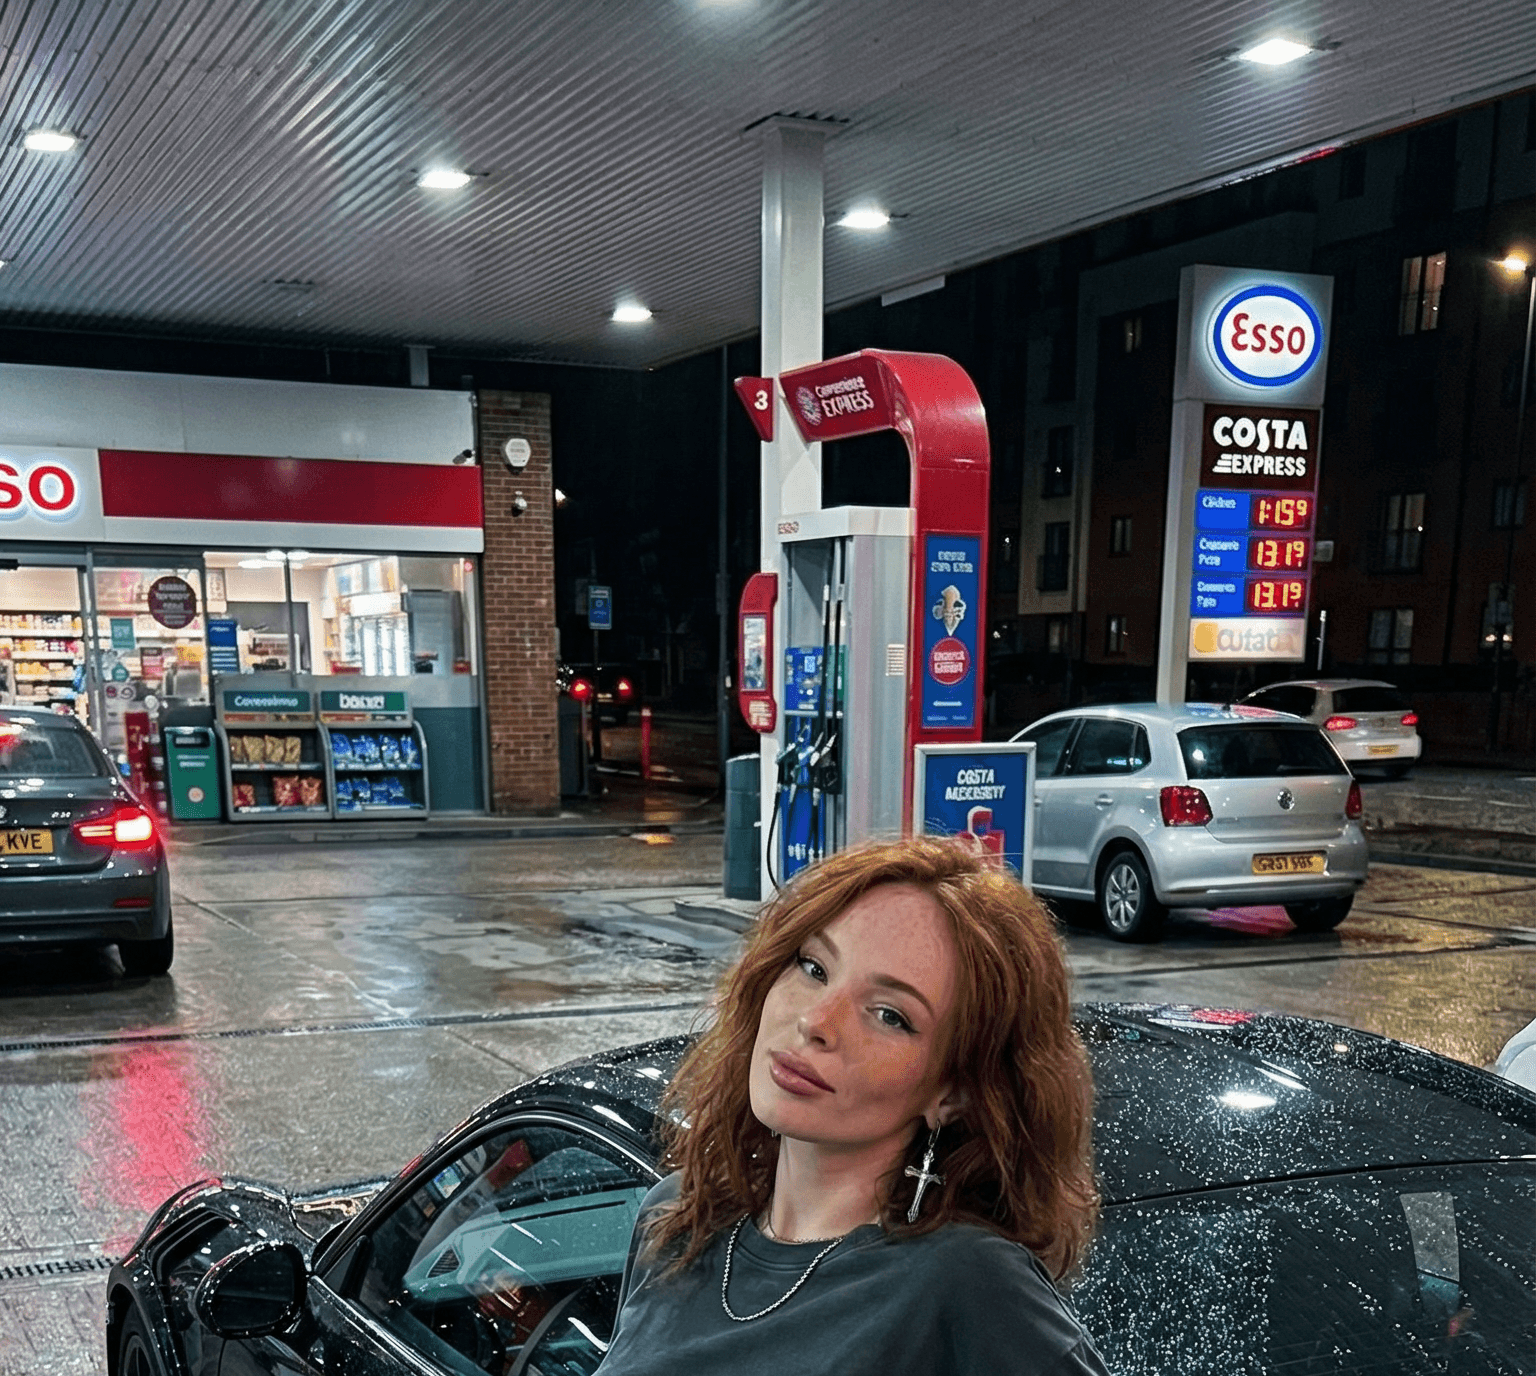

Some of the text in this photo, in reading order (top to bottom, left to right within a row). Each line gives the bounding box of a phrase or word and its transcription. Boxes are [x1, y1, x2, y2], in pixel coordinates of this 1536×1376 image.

[754, 389, 769, 411] 3
[1213, 416, 1308, 453] COSTA
[1230, 454, 1307, 477] EXPRESS
[7, 832, 42, 850] KVE
